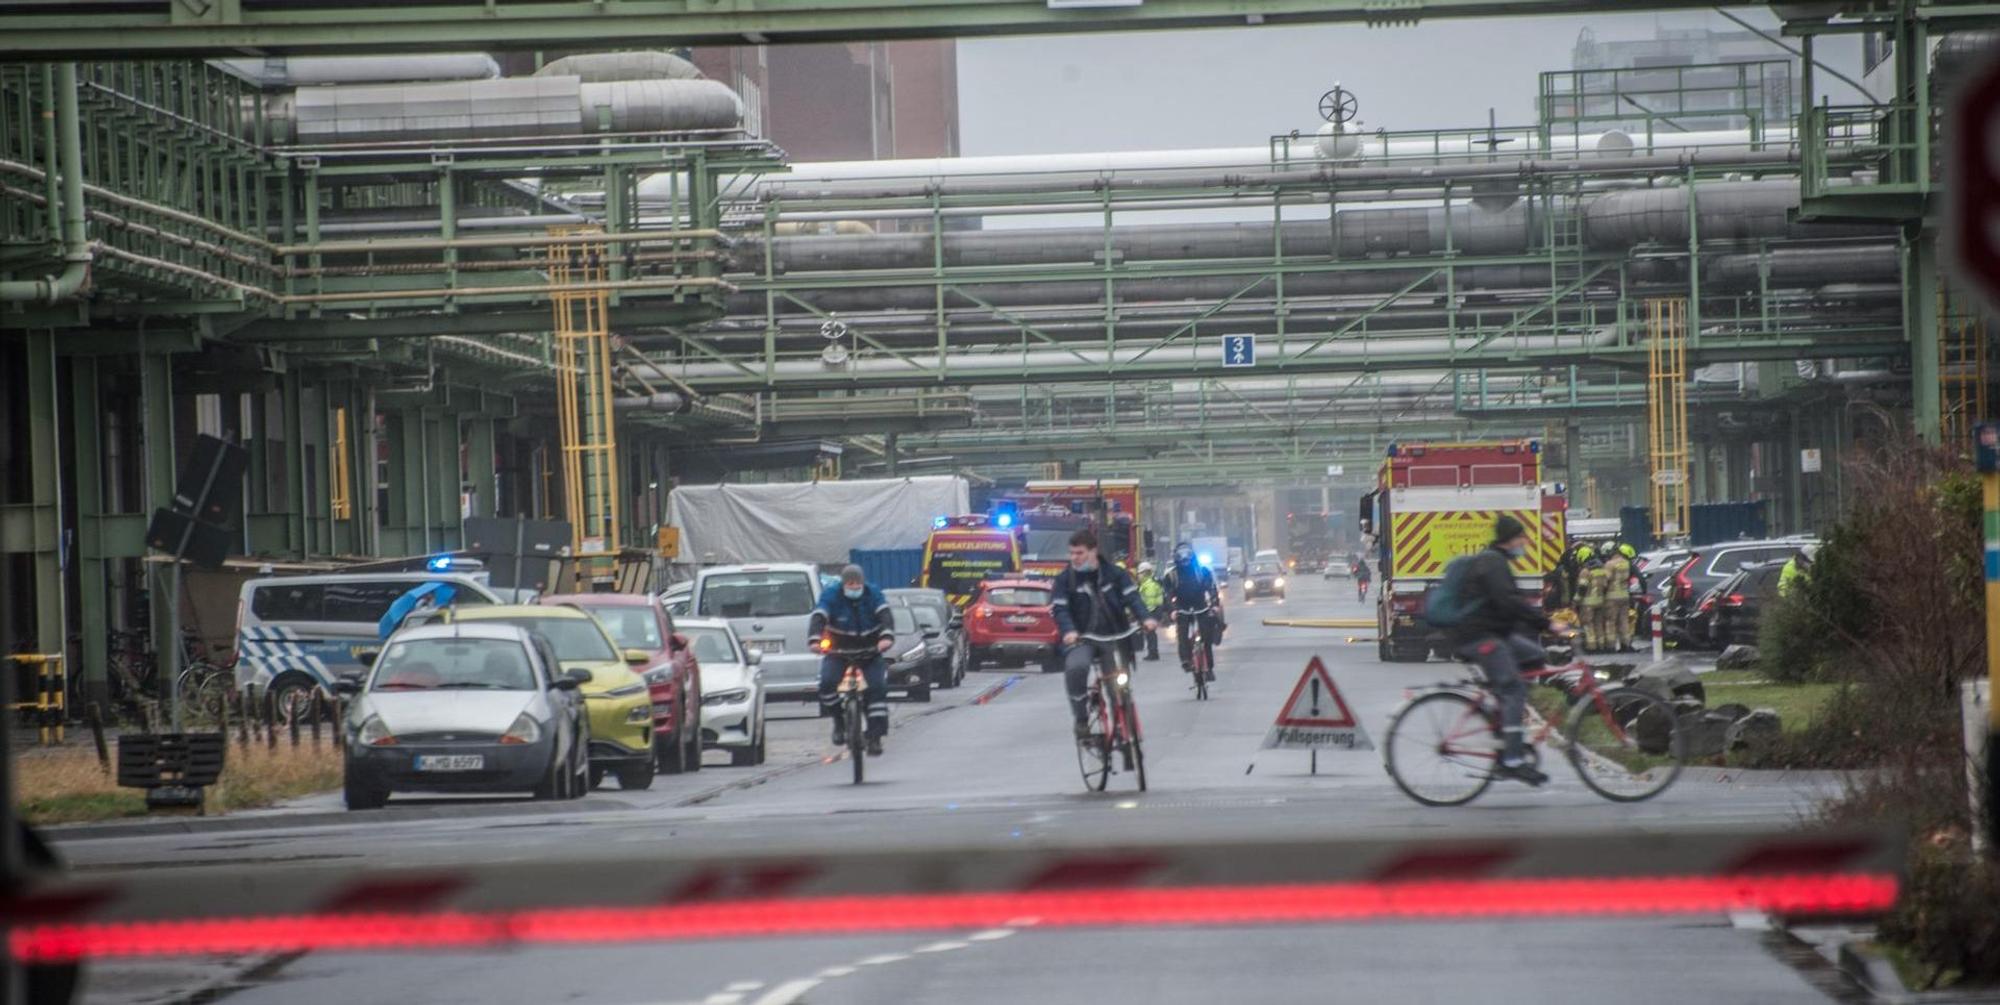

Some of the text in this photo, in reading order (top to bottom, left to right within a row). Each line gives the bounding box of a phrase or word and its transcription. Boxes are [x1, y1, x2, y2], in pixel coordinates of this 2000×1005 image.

[1233, 337, 1244, 353] 3
[937, 542, 1006, 551] EINSATZLEITUNG
[1277, 728, 1355, 749] Vollsperrung
